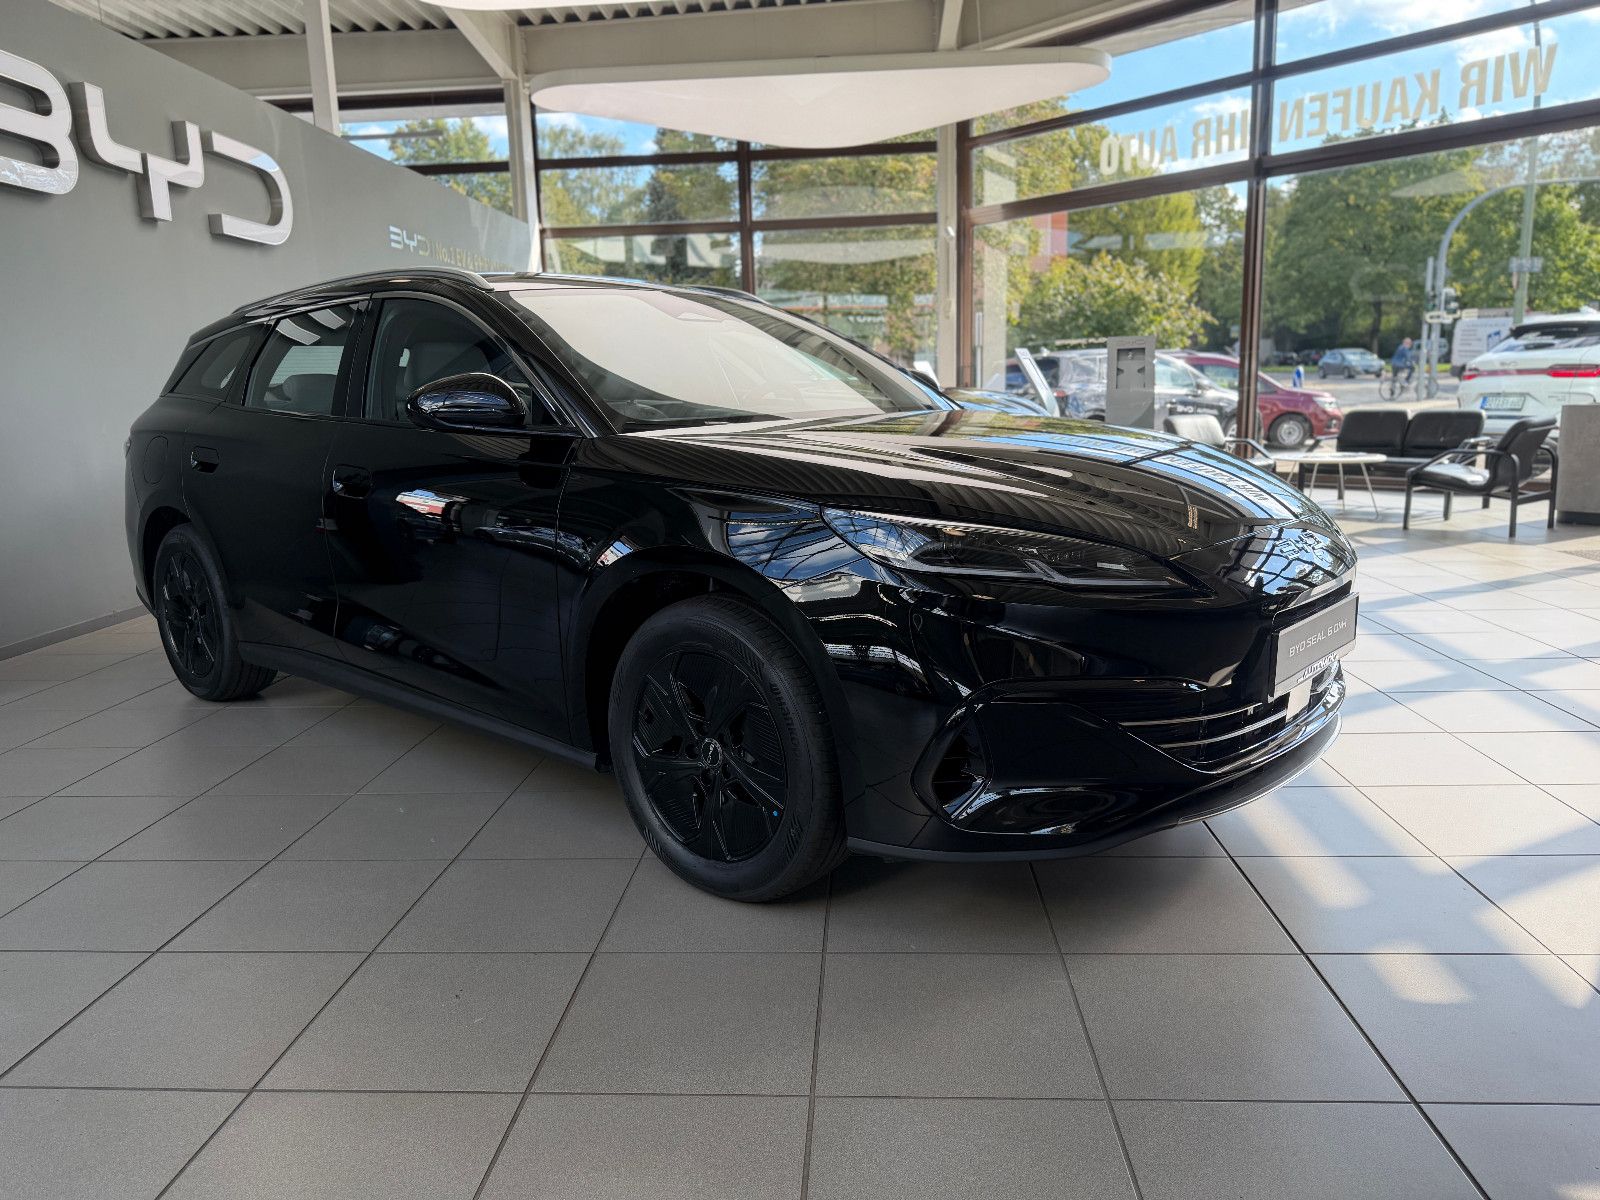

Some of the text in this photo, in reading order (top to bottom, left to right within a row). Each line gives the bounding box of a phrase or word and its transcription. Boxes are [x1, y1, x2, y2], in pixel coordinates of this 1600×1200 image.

[0, 50, 293, 245] BYD
[389, 225, 430, 256] BYD
[1289, 641, 1306, 658] BYD
[1306, 631, 1326, 648] SEAL
